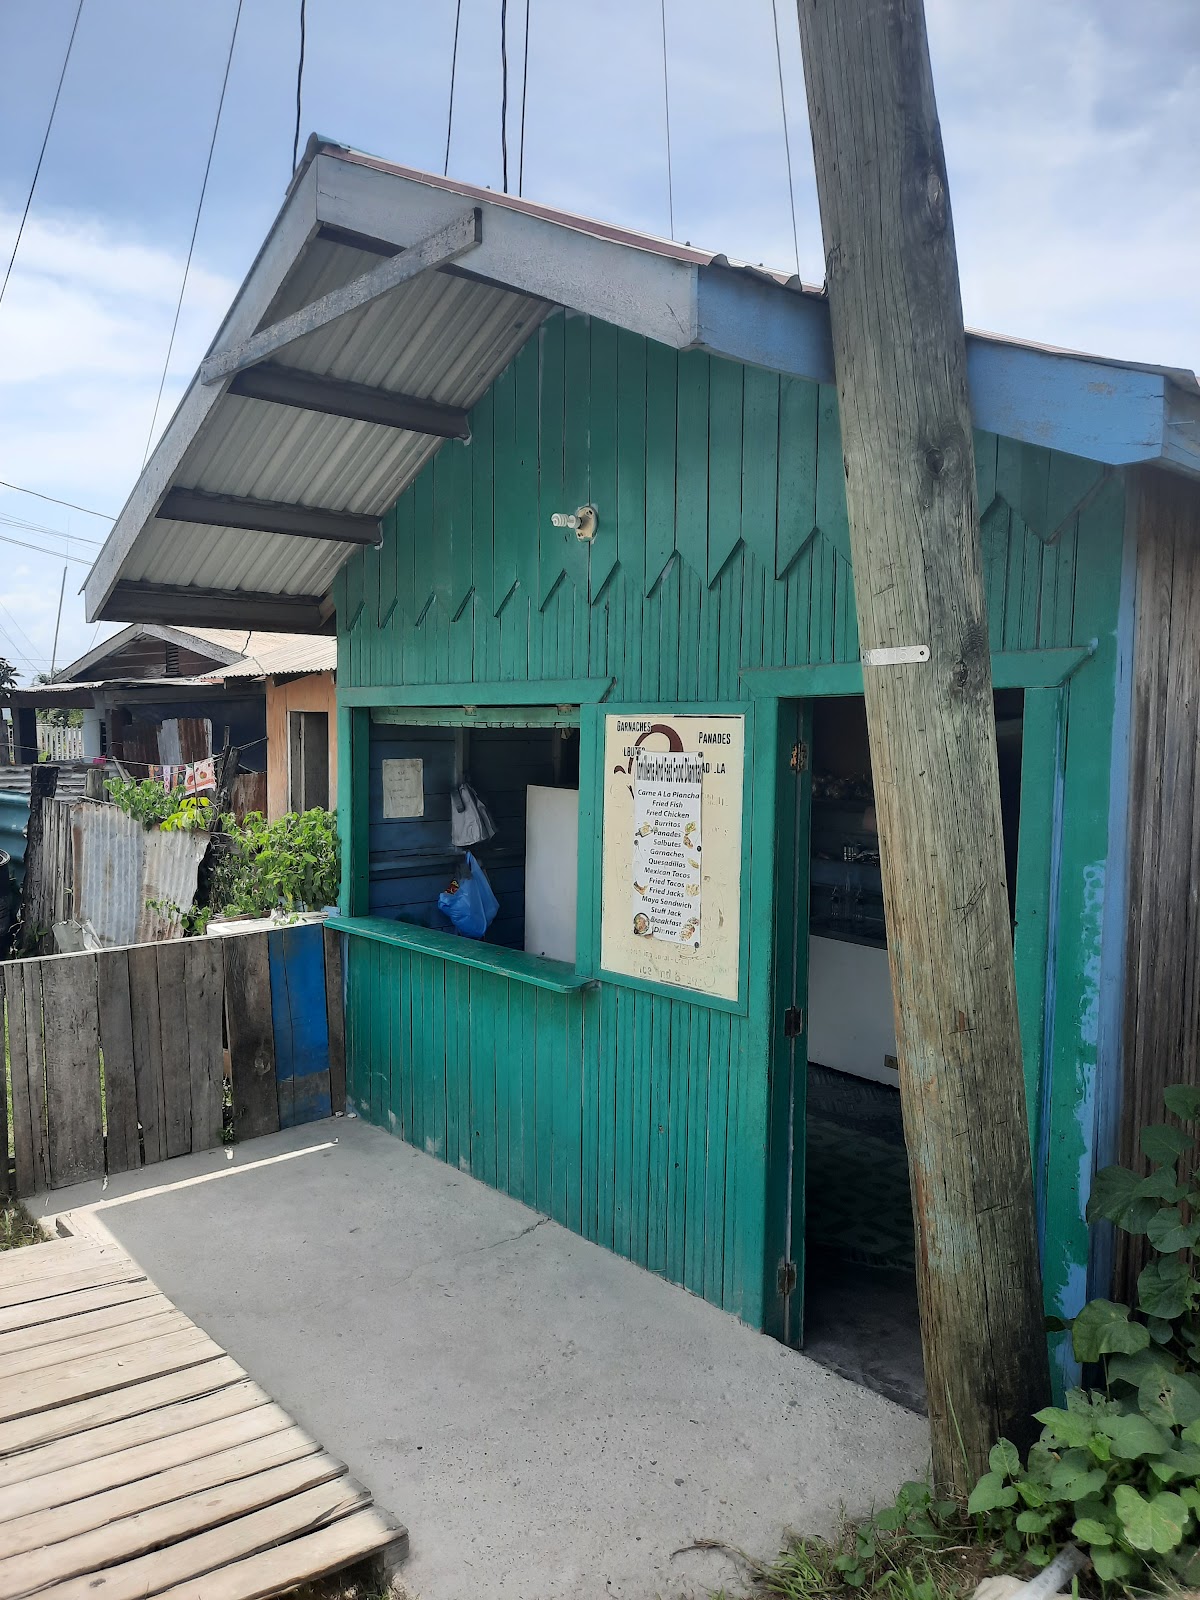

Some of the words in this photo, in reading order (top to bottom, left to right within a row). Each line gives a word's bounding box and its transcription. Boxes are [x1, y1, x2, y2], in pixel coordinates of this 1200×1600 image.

[616, 720, 651, 732] GARNACHES
[698, 731, 731, 745] PANADES
[672, 791, 700, 799] Plancha
[646, 809, 663, 817] Fried
[663, 810, 690, 819] Chicken
[654, 820, 681, 828] Burritos
[653, 830, 681, 838] Panades
[653, 839, 681, 848] Salbutes
[650, 848, 685, 858] Garnaches
[648, 858, 686, 868] Quesadillas
[644, 867, 671, 876] Mexican
[672, 870, 691, 879] Tacos
[649, 877, 666, 885] Fried
[667, 880, 685, 888] Tacos
[649, 887, 666, 895] Fried
[666, 889, 684, 898] Jacks
[641, 895, 659, 905] Maya
[660, 898, 692, 909] Sandwich
[651, 906, 666, 915] Stuff
[667, 909, 682, 917] Jack
[650, 915, 682, 927] Breakfast
[653, 926, 677, 936] Diner
